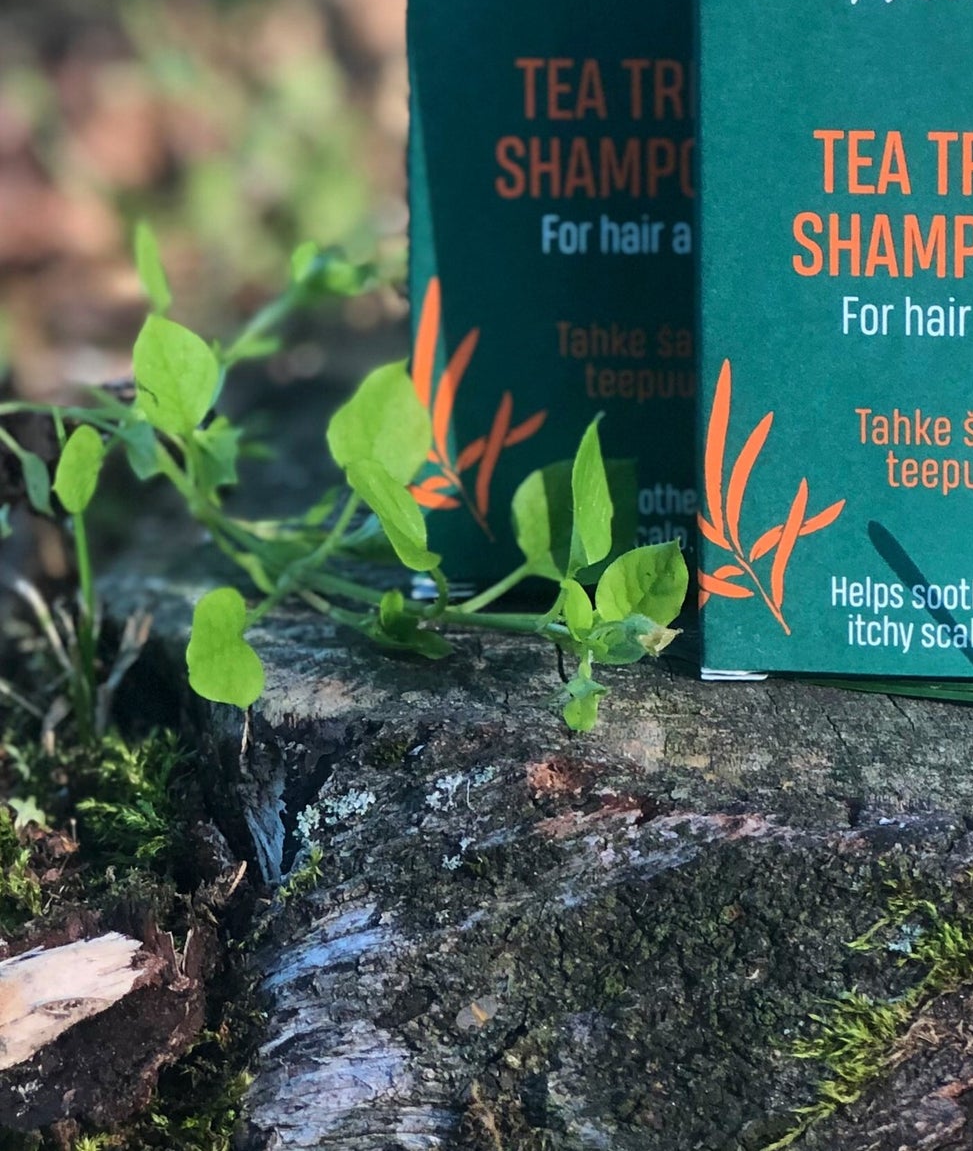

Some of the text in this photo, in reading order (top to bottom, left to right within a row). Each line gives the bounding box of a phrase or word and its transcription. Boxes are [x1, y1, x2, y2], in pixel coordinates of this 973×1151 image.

[515, 58, 694, 120] TEA TR
[813, 129, 911, 194] TEA
[541, 213, 593, 255] For
[600, 213, 665, 255] hair
[842, 295, 894, 336] For
[904, 296, 972, 337] hair
[556, 320, 646, 359] Tahke
[585, 362, 697, 405] teepuu
[855, 408, 951, 446] Tahke
[638, 482, 697, 515] othe
[831, 575, 904, 614] Helps
[848, 613, 914, 654] itchy
